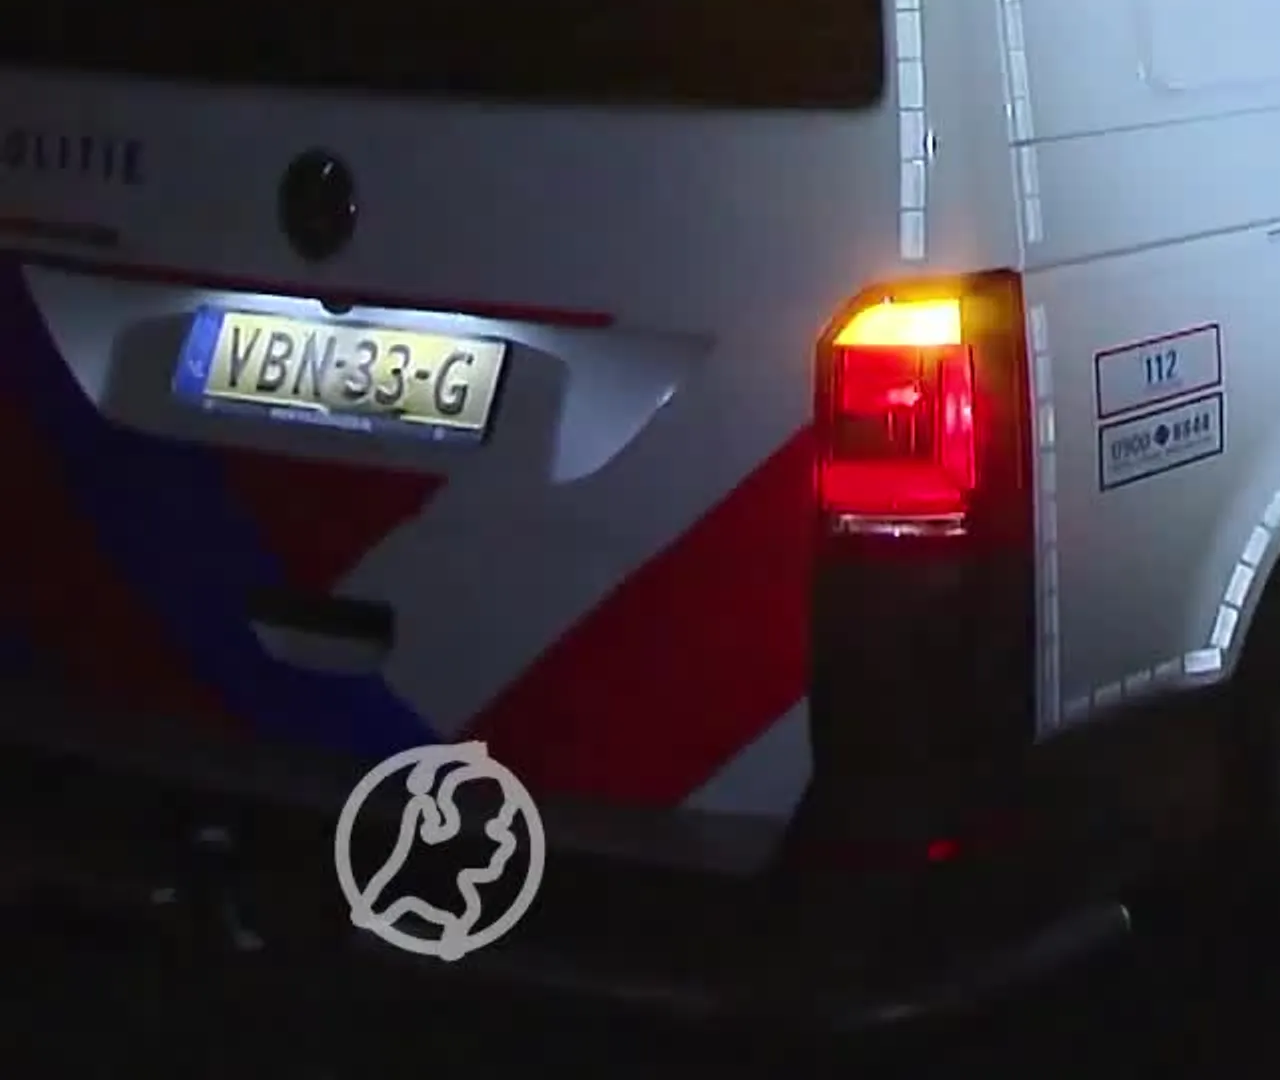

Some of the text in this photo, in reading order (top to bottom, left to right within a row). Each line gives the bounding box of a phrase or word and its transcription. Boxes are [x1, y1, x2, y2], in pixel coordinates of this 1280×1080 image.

[4, 127, 145, 185] OLITIE
[228, 326, 474, 417] VBN-33-G
[1145, 349, 1178, 384] 112
